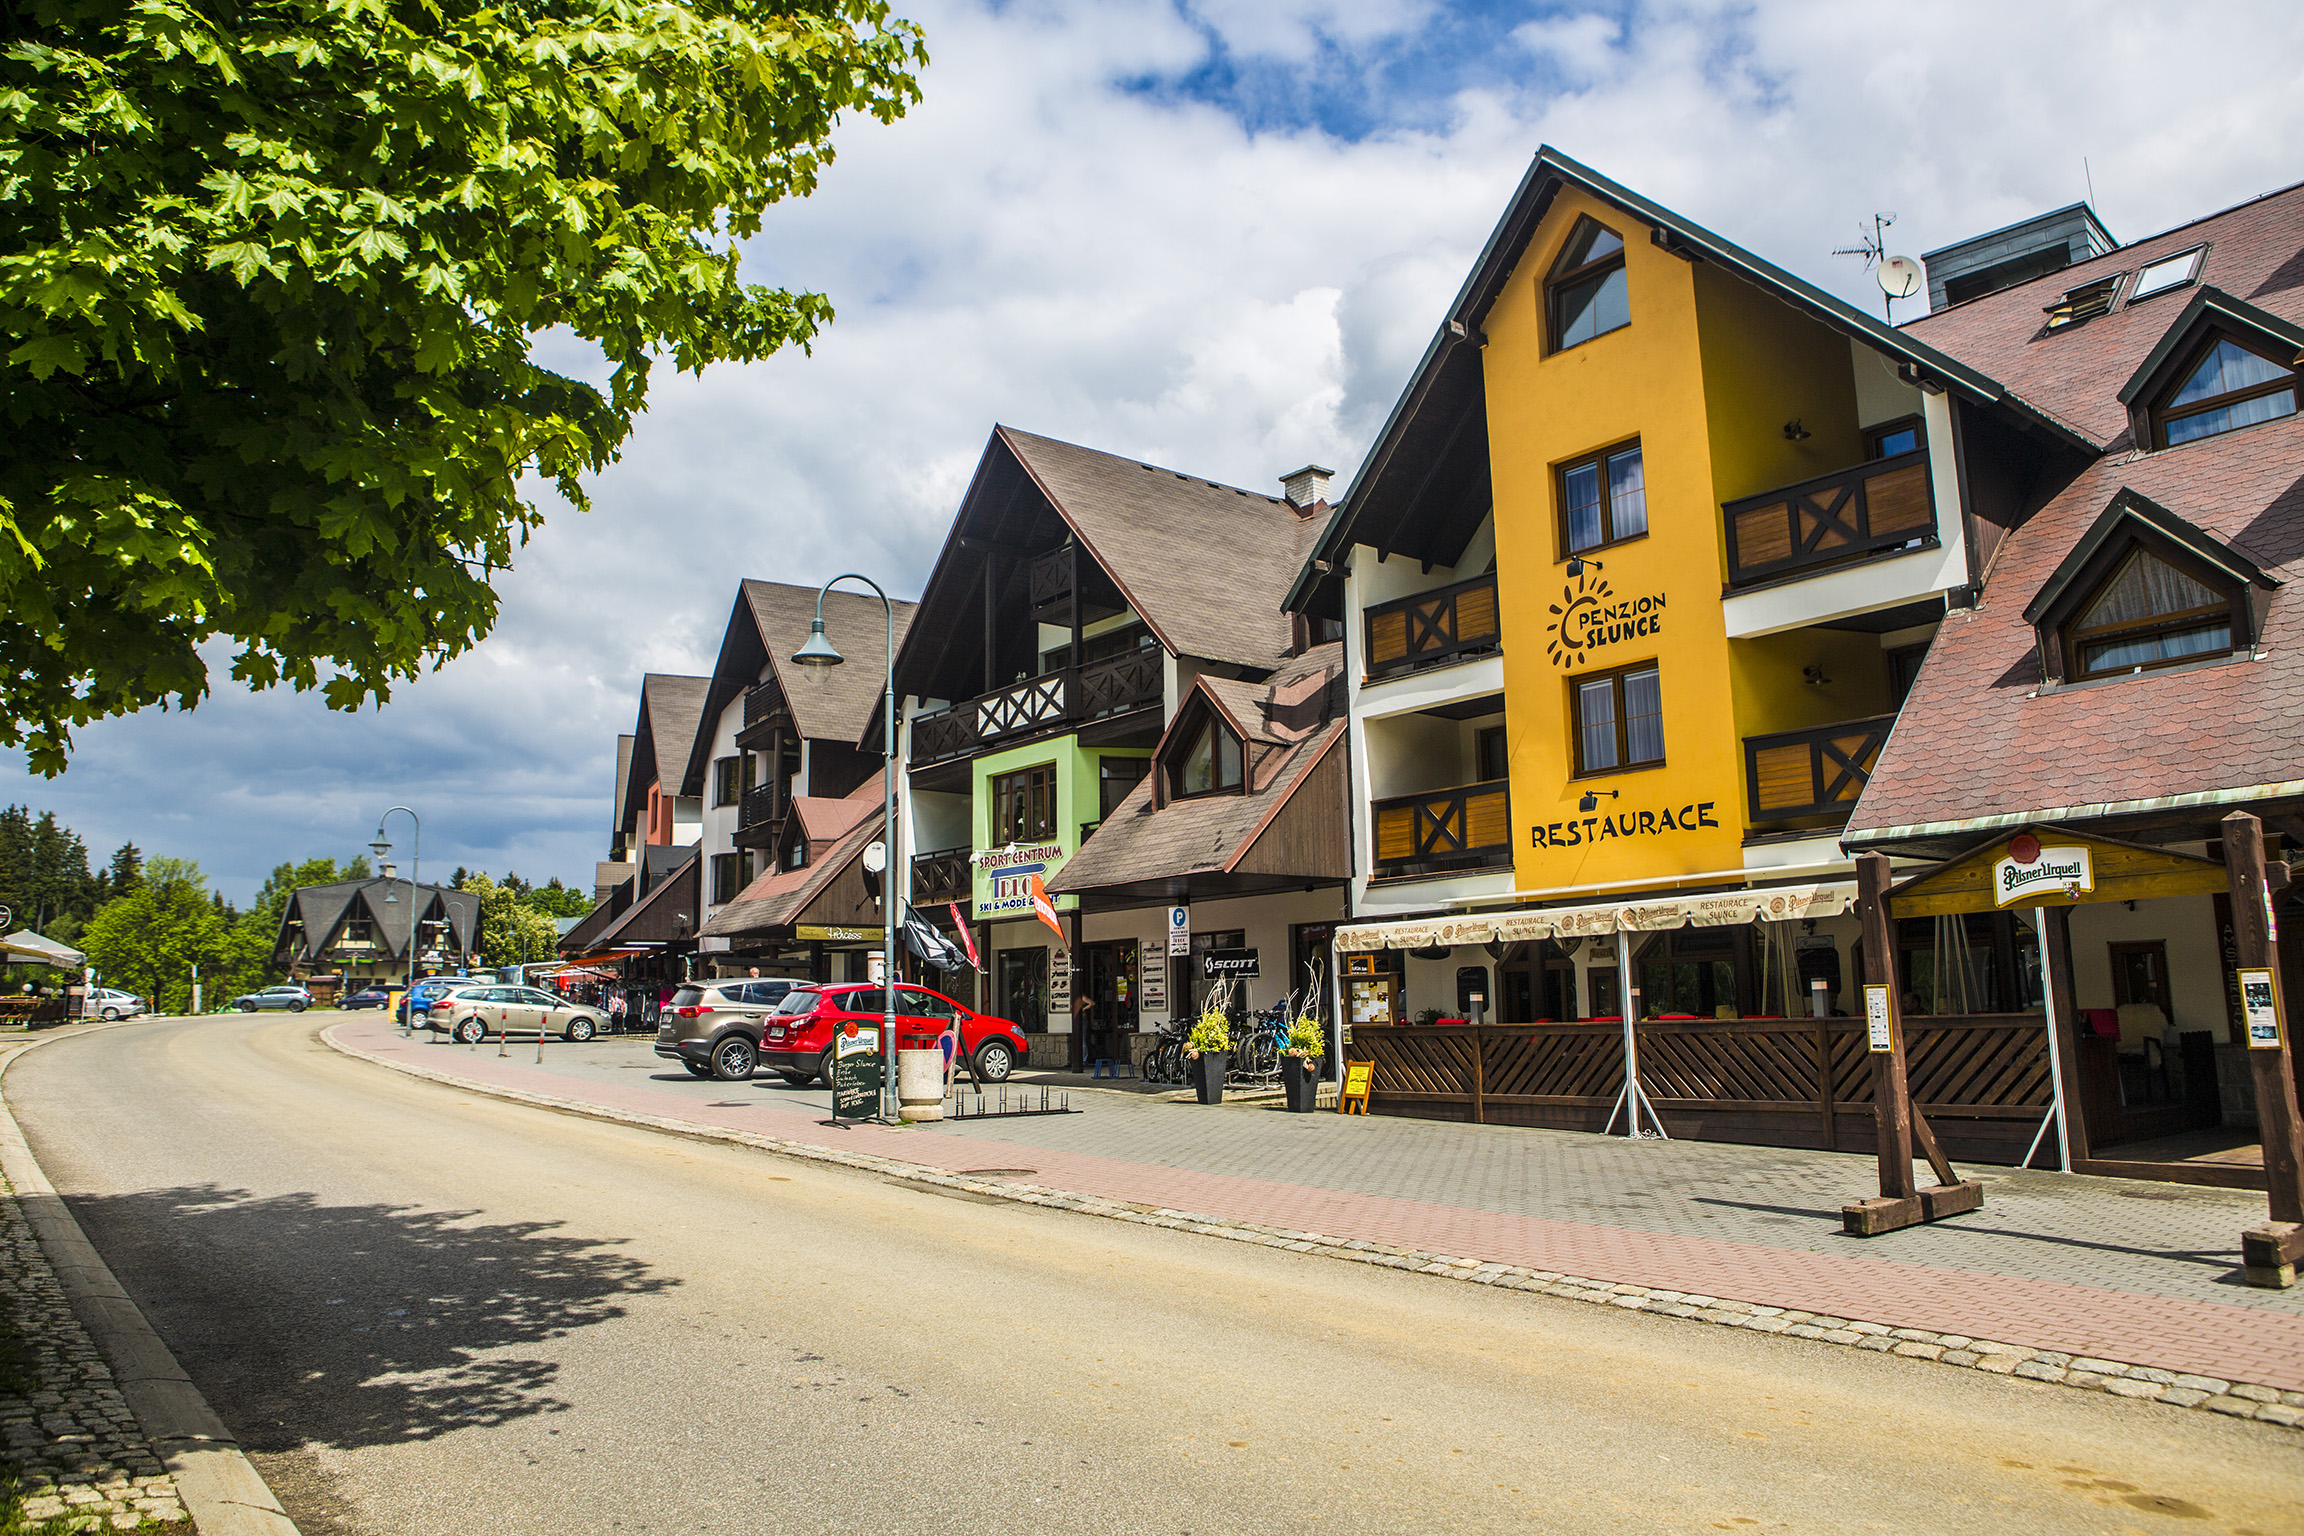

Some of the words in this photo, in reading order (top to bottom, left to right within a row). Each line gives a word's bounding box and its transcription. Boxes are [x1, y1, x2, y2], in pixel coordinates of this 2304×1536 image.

[1579, 592, 1667, 630] PENZION
[1586, 613, 1661, 649] SLUNCE
[1531, 801, 1719, 849] RESTAURACE
[979, 854, 1010, 869] SPORT
[1012, 845, 1063, 864] CENTRUM
[2003, 865, 2043, 892] Pilsner
[2041, 862, 2081, 880] Urquell
[979, 902, 992, 912] SKI
[994, 901, 1000, 910] &
[1001, 898, 1026, 909] MODE
[1700, 899, 1748, 910] RESTAURACE
[1788, 894, 1812, 912] Pilsner
[1811, 891, 1835, 906] Urquell
[1176, 911, 1184, 924] P
[1505, 917, 1544, 926] RESTAURACE
[1576, 914, 1596, 930] Pilsner
[1595, 911, 1613, 923] Urquell
[1638, 907, 1659, 924] Pilsner
[1658, 904, 1679, 917] Urquell
[1708, 910, 1738, 920] SLUNCE
[1394, 926, 1429, 935] RESTAURACE
[1454, 923, 1473, 938] Pilsner
[1472, 921, 1489, 933] Urquell
[1512, 927, 1536, 936] SLUNCE
[1399, 935, 1421, 943] SLUNCE
[1213, 958, 1256, 969] SCOTT
[840, 1037, 858, 1051] Pilsner
[857, 1036, 874, 1047] Urquell
